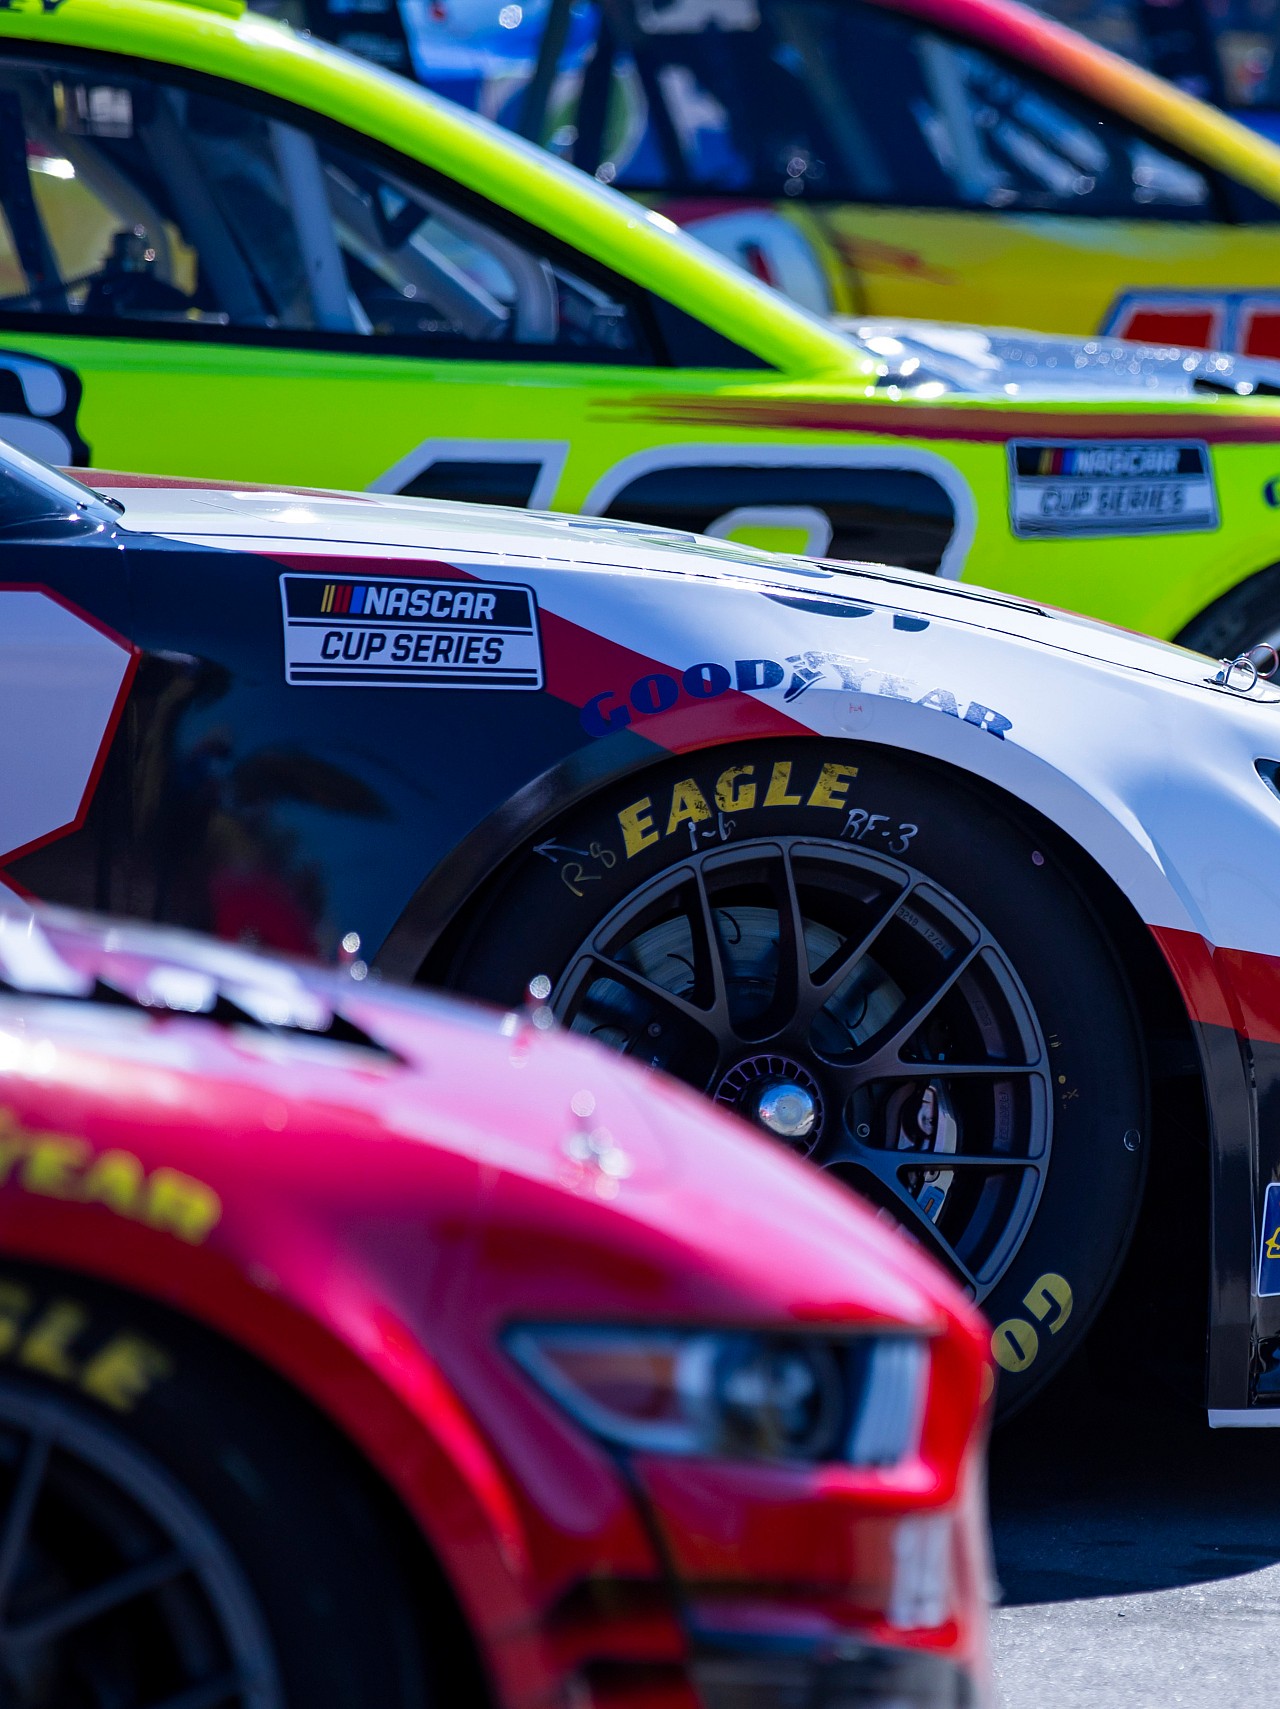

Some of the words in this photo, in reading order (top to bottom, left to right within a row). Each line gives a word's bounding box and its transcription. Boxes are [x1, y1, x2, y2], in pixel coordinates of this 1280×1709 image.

[363, 586, 497, 620] NASCAR
[320, 630, 388, 662] CUP
[389, 633, 505, 665] SERIES
[580, 650, 1013, 741] GOODYEAR
[617, 761, 859, 859] EAGLE
